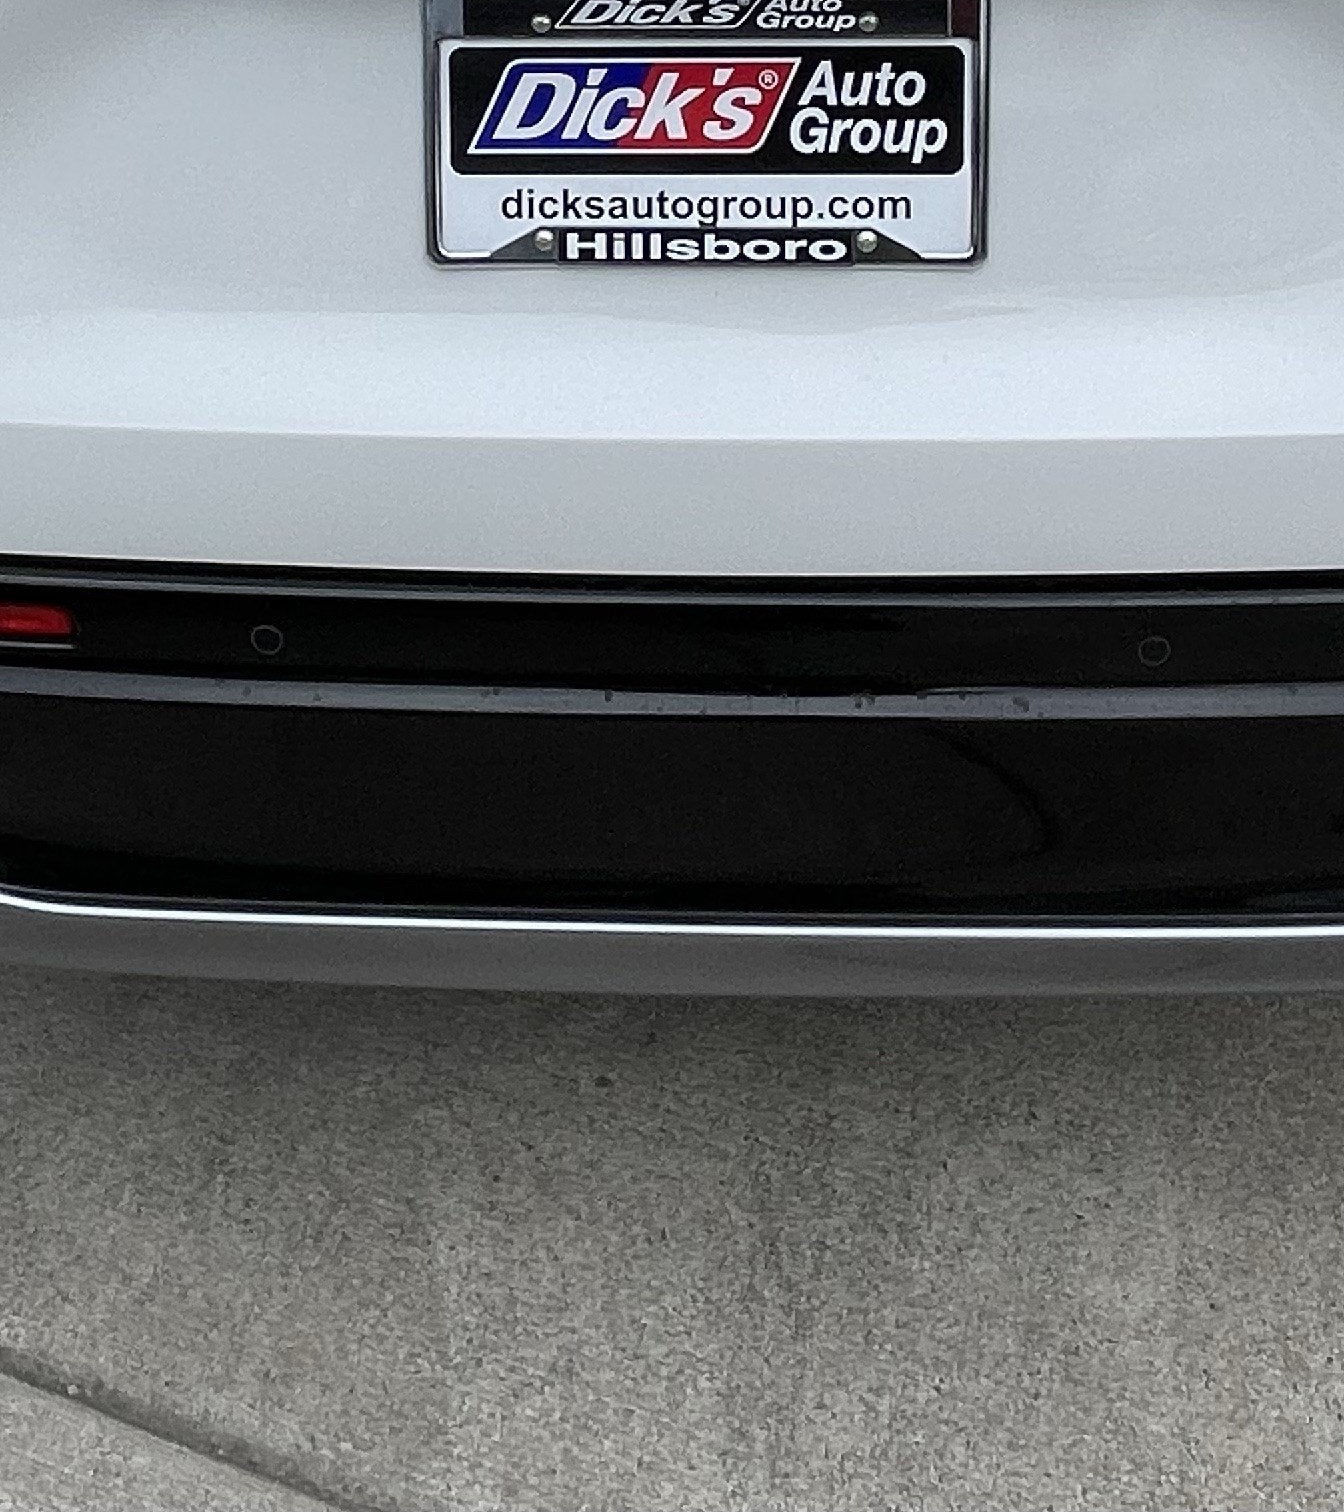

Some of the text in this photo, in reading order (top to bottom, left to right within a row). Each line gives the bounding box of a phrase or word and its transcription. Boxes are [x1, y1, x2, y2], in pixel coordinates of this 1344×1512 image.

[756, 12, 856, 32] Group
[798, 60, 926, 106] Auto
[790, 107, 948, 164] Group
[501, 189, 913, 227] dicksautogroup.com
[566, 232, 848, 261] Hillsboro
